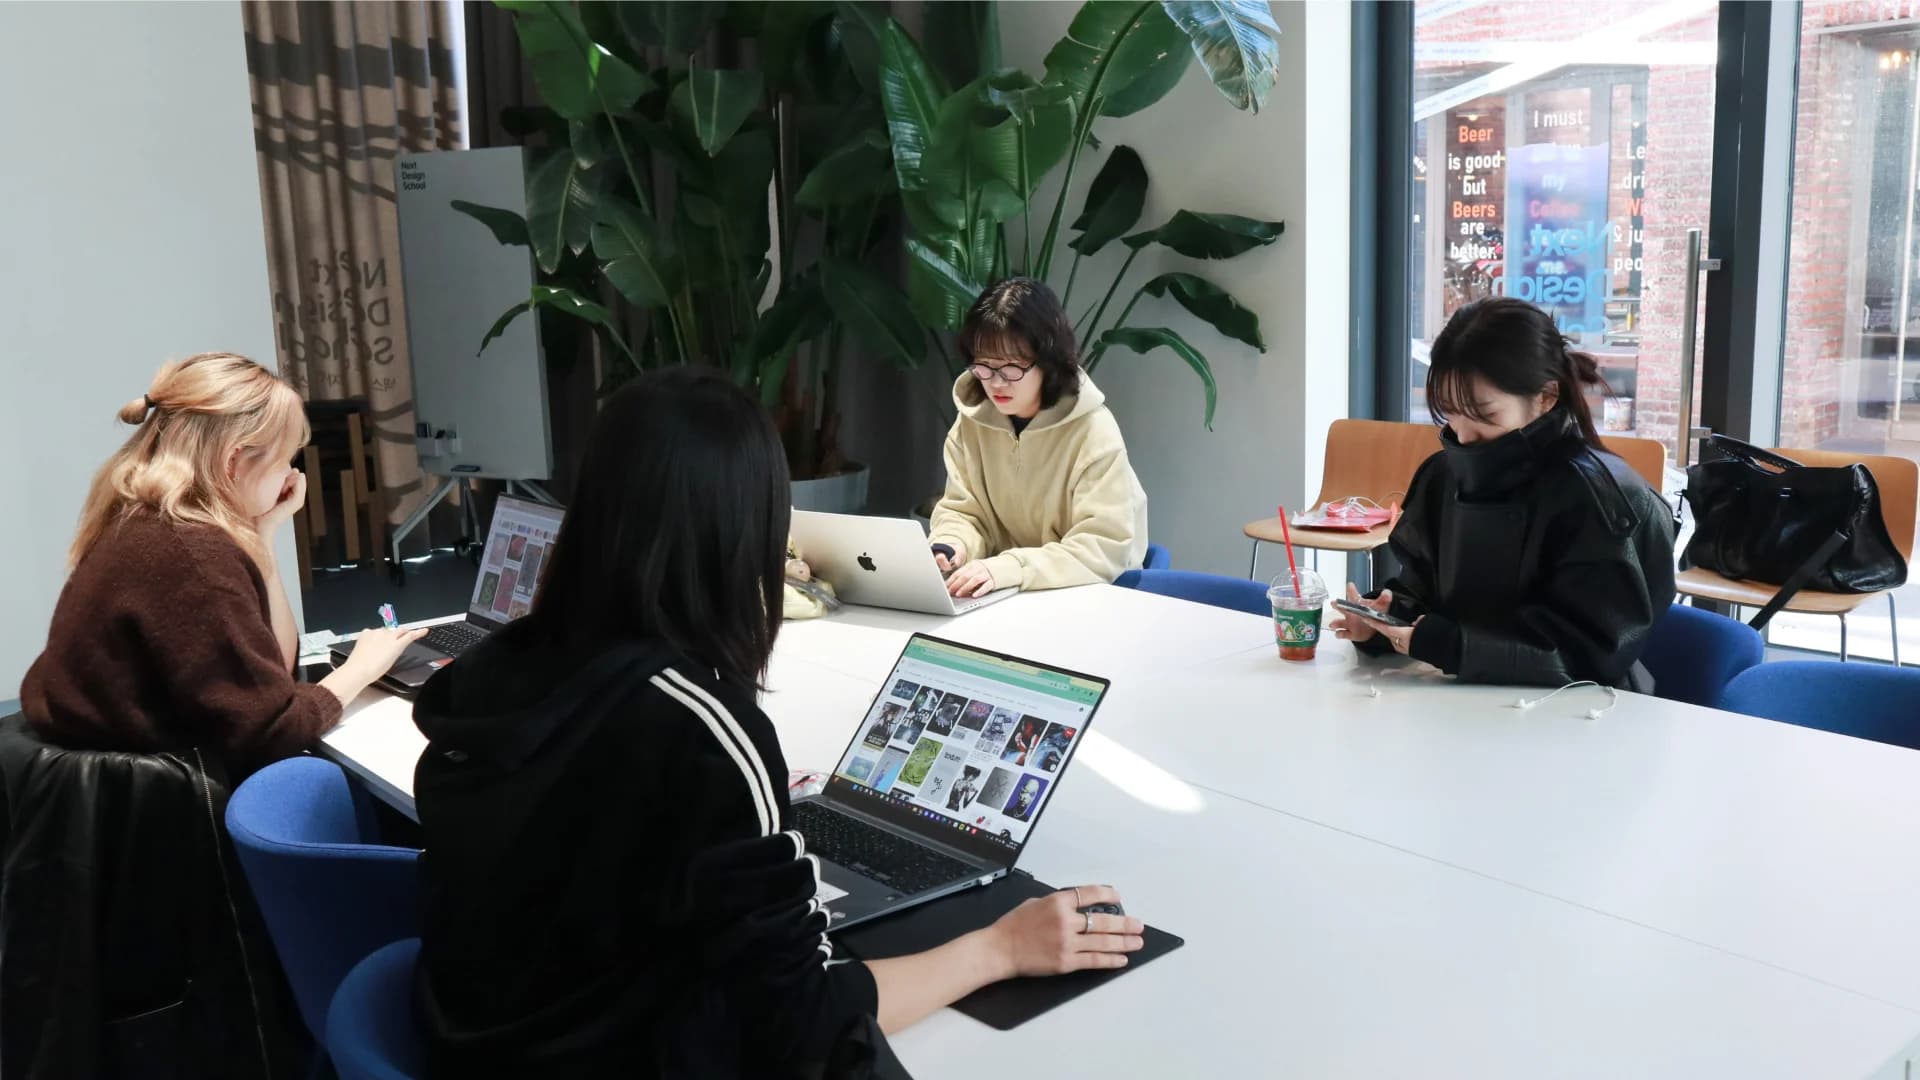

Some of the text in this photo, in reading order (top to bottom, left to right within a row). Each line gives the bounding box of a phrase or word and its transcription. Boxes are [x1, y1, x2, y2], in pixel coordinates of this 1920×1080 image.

[1534, 109, 1583, 127] I must
[1458, 125, 1494, 143] Beer
[401, 161, 416, 169] Next
[1448, 153, 1460, 170] is
[1465, 150, 1501, 173] good
[402, 171, 425, 181] Design
[403, 181, 425, 190] School
[1463, 176, 1486, 195] but
[1453, 201, 1495, 218] Beers
[1460, 221, 1484, 235] are
[1450, 239, 1497, 259] better.
